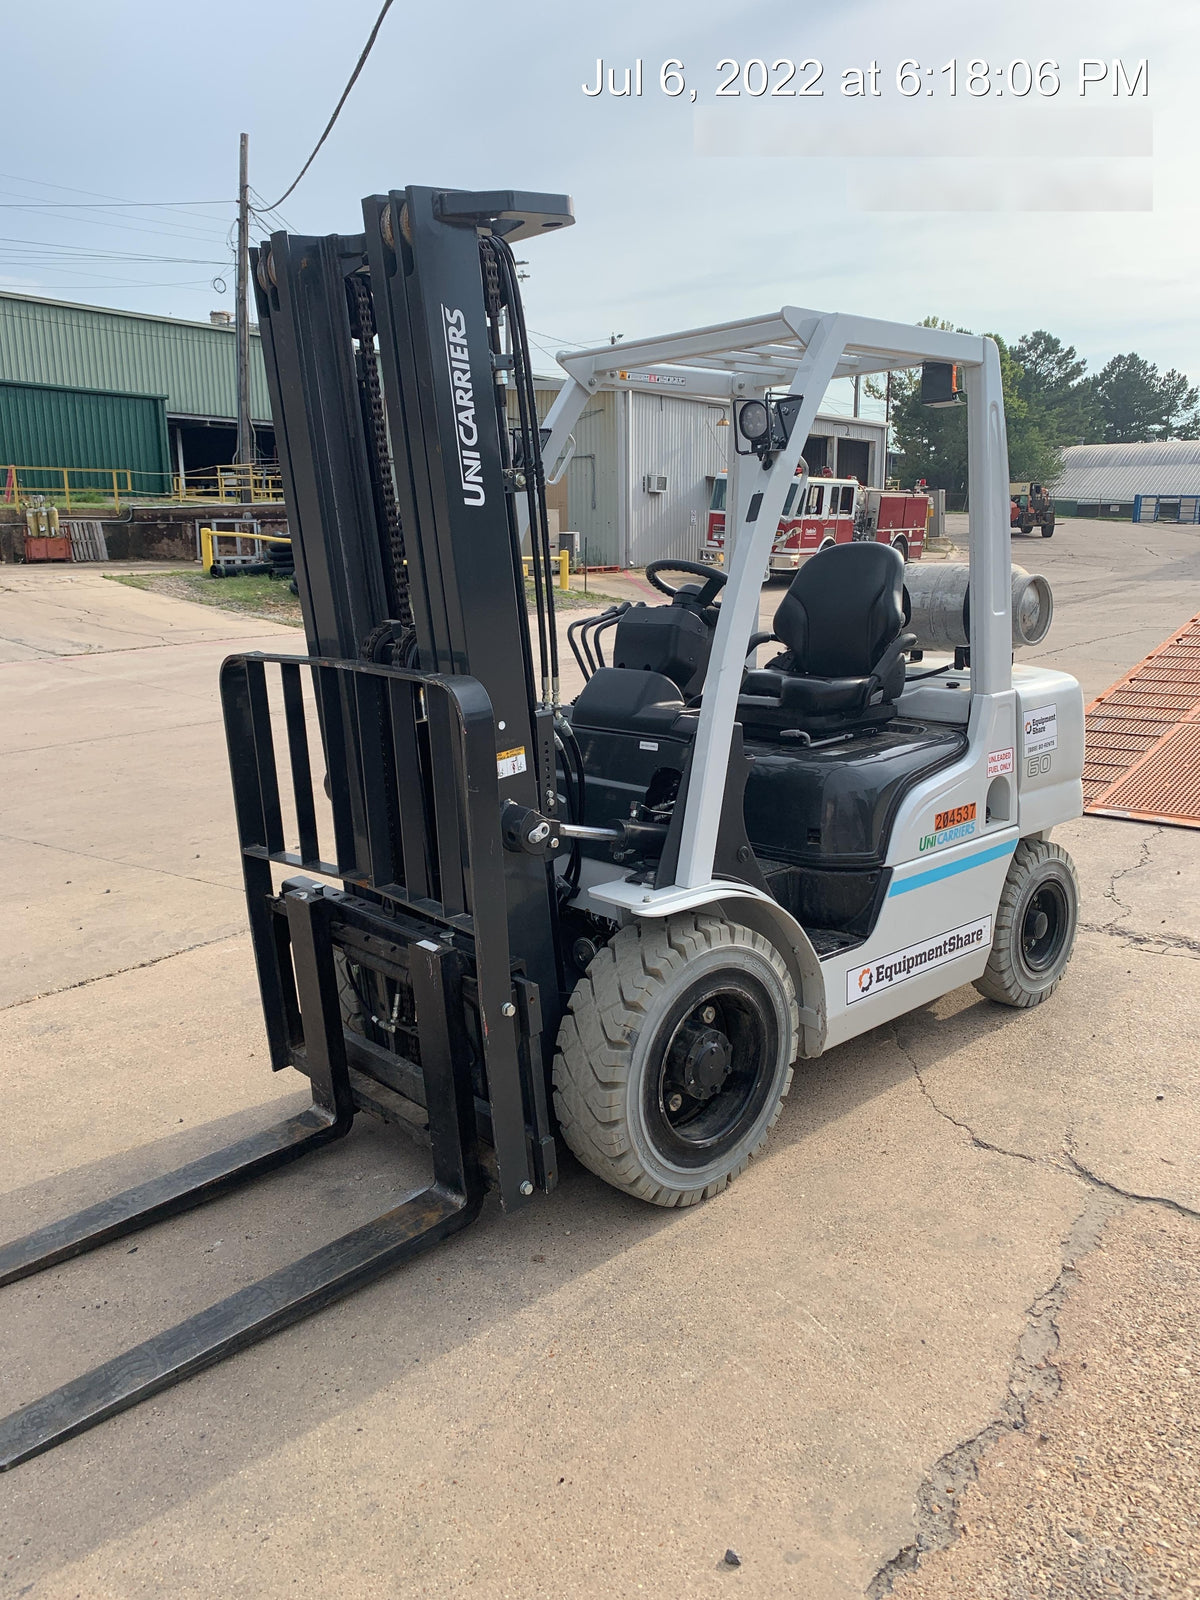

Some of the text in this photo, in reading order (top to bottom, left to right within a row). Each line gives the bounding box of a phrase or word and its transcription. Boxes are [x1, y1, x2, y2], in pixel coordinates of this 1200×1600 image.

[1032, 714, 1056, 727] Equipment
[1032, 726, 1046, 735] Share
[988, 752, 1011, 764] UNLEADED
[988, 762, 1011, 774] FUEL ONLY
[935, 802, 976, 831] 204537
[875, 928, 983, 983] EquipmentShare
